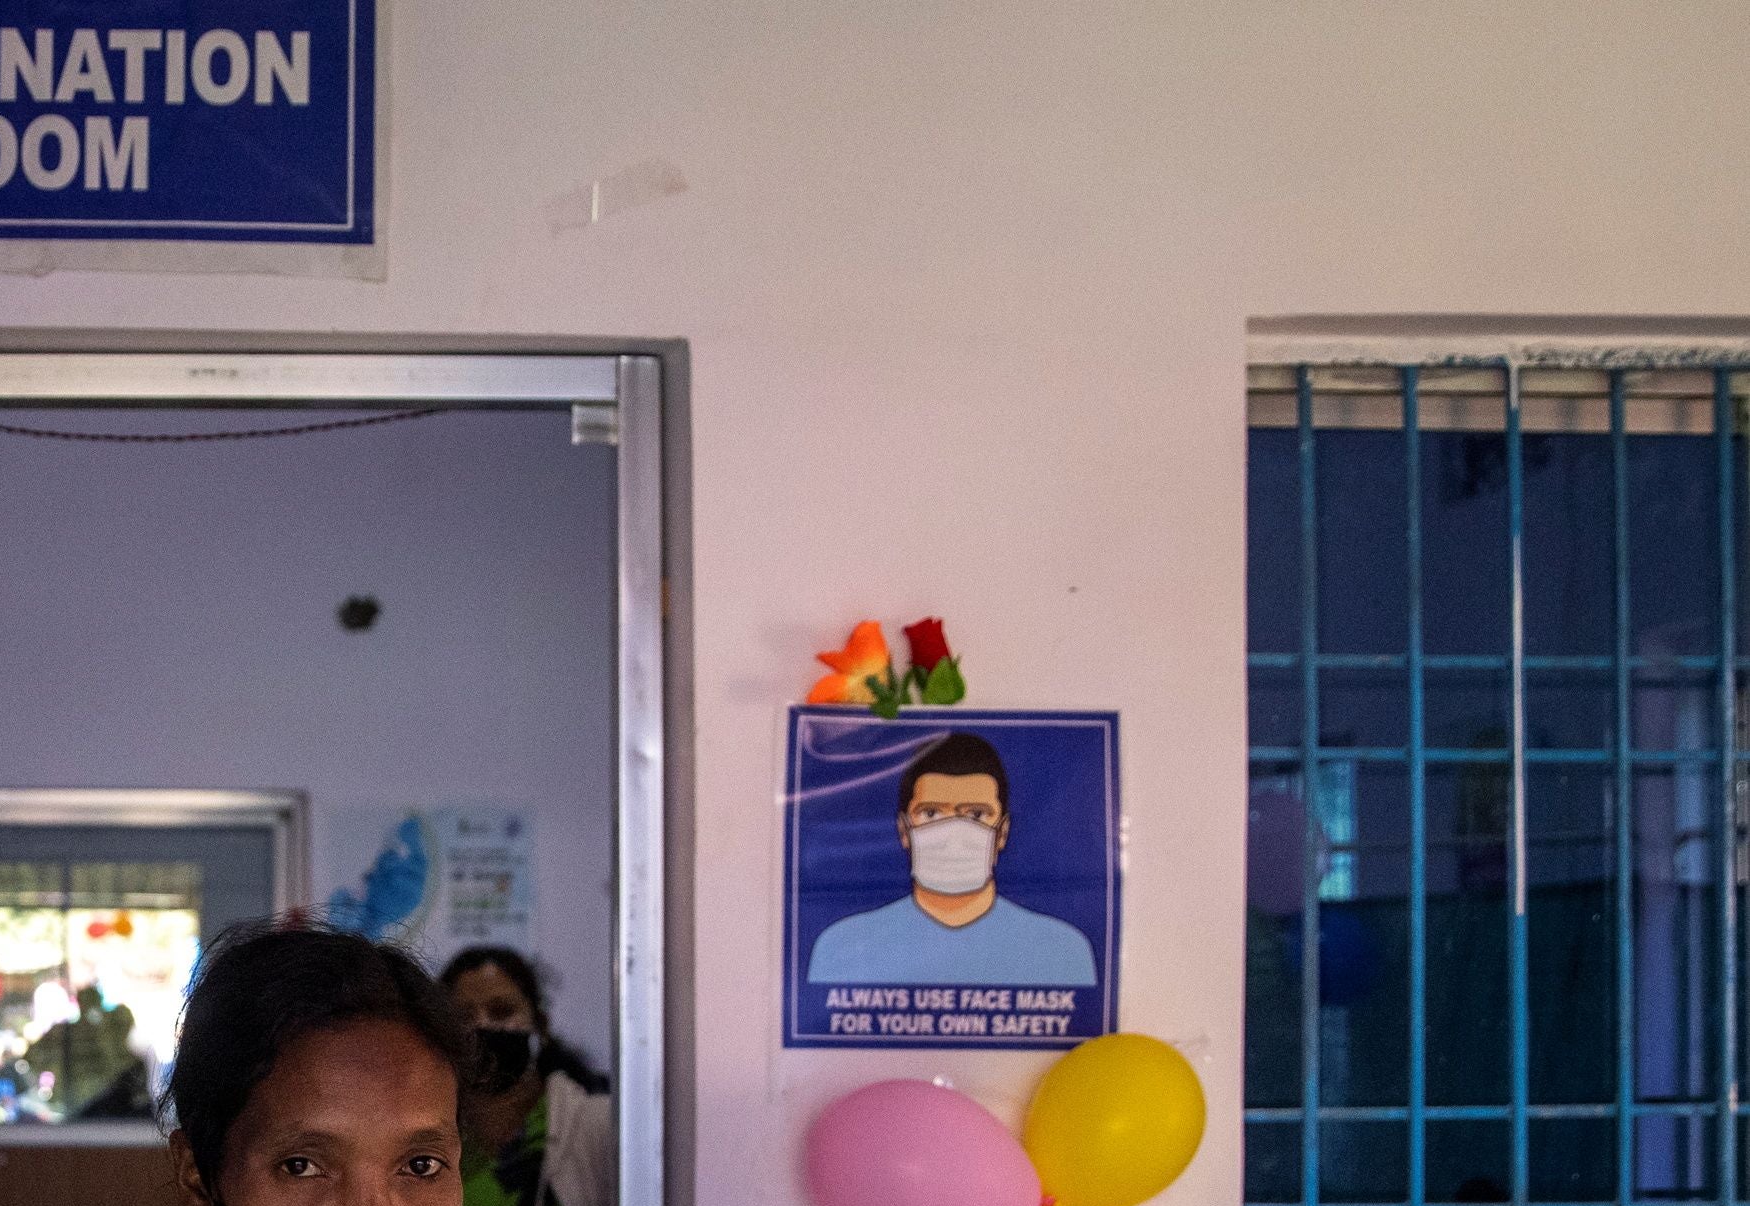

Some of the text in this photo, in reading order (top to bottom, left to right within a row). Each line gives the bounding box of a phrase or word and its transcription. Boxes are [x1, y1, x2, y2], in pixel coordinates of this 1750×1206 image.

[826, 988, 1076, 1012] ALWAYS USE FACE MASK
[830, 1013, 1071, 1036] FOR YOUR OWN SAFETY
